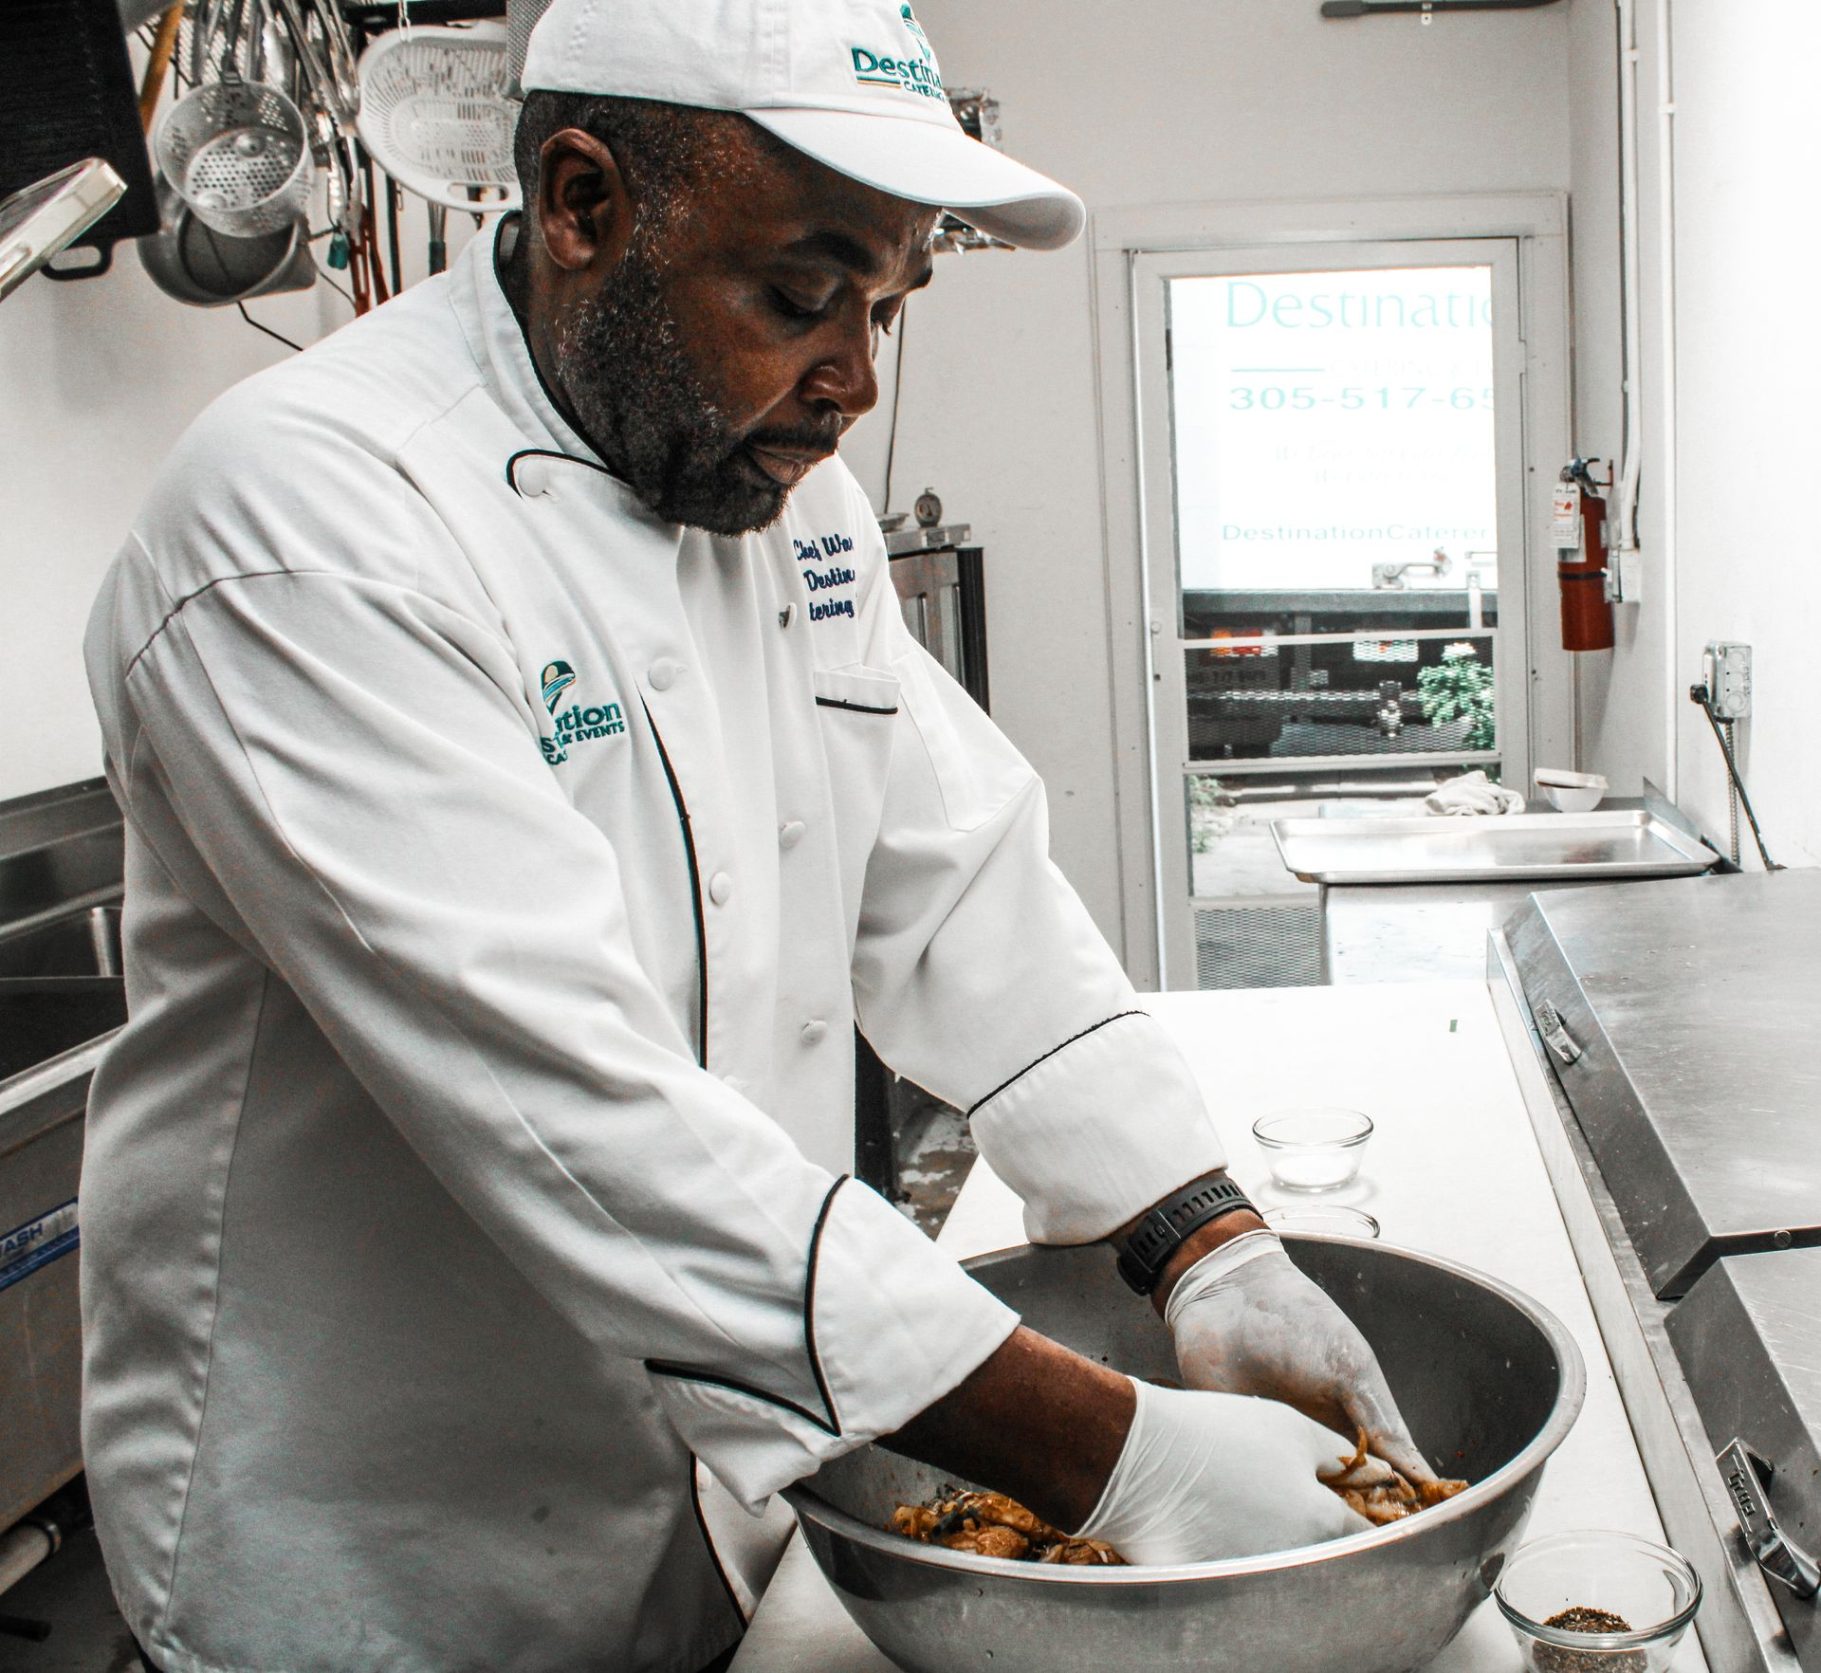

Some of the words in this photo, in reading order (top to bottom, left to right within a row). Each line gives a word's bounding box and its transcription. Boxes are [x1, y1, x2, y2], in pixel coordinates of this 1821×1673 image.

[822, 533, 854, 557] Wa
[575, 721, 625, 743] EVENTS
[0, 1223, 43, 1253] ASH
